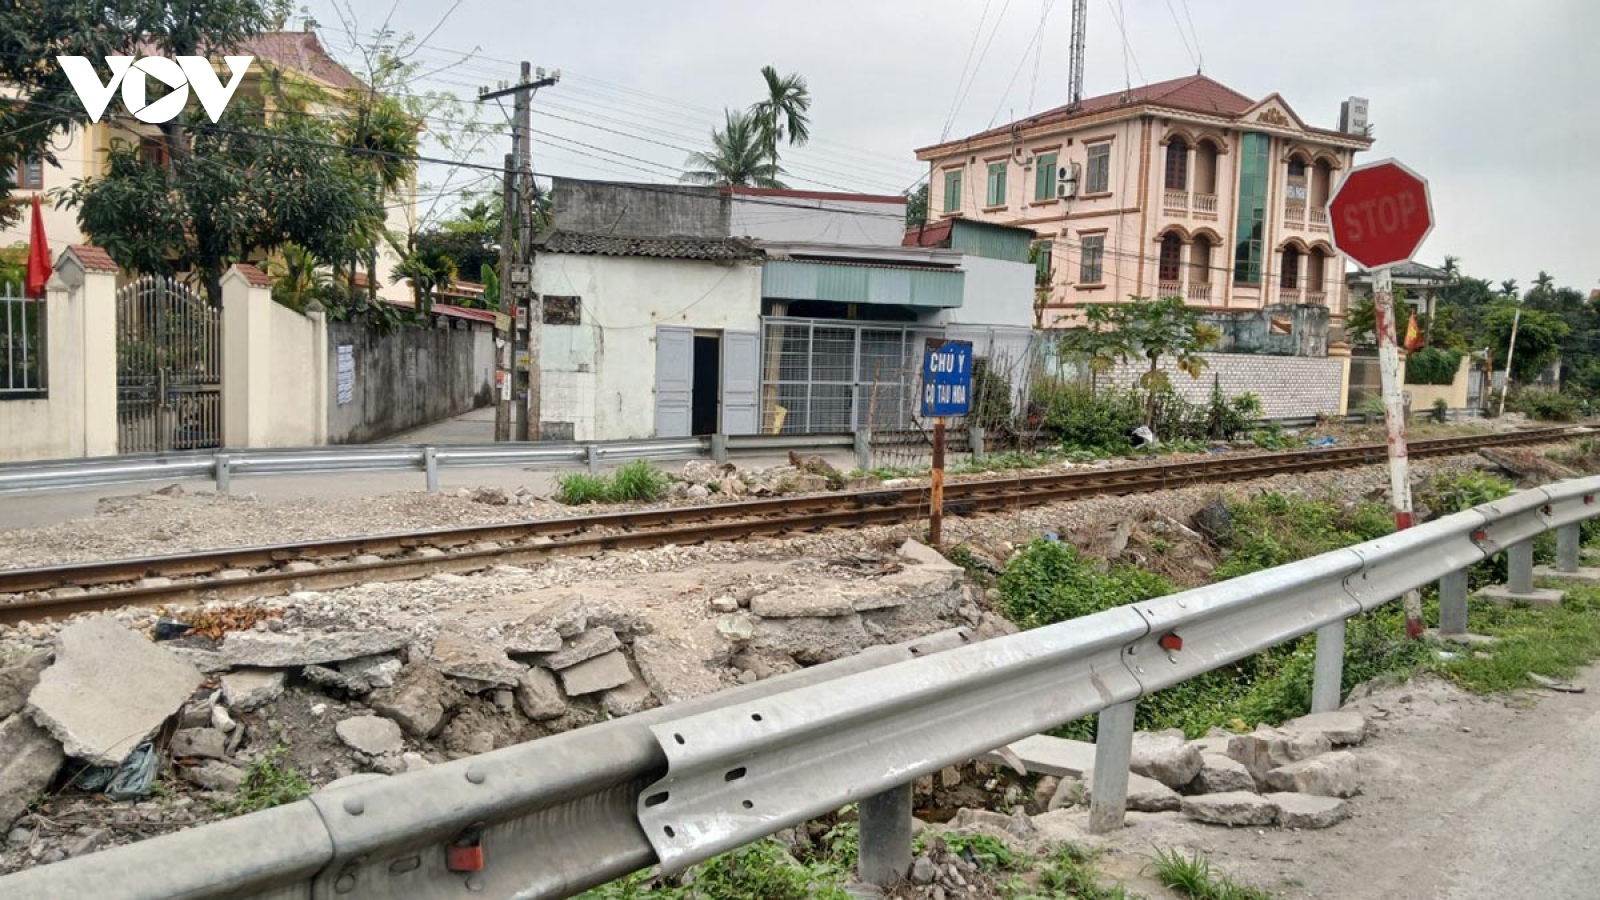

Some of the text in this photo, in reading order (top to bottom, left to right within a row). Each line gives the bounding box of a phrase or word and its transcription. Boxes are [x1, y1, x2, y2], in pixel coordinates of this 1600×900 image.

[1344, 190, 1416, 241] STOP
[930, 348, 965, 374] CHÚ Ý
